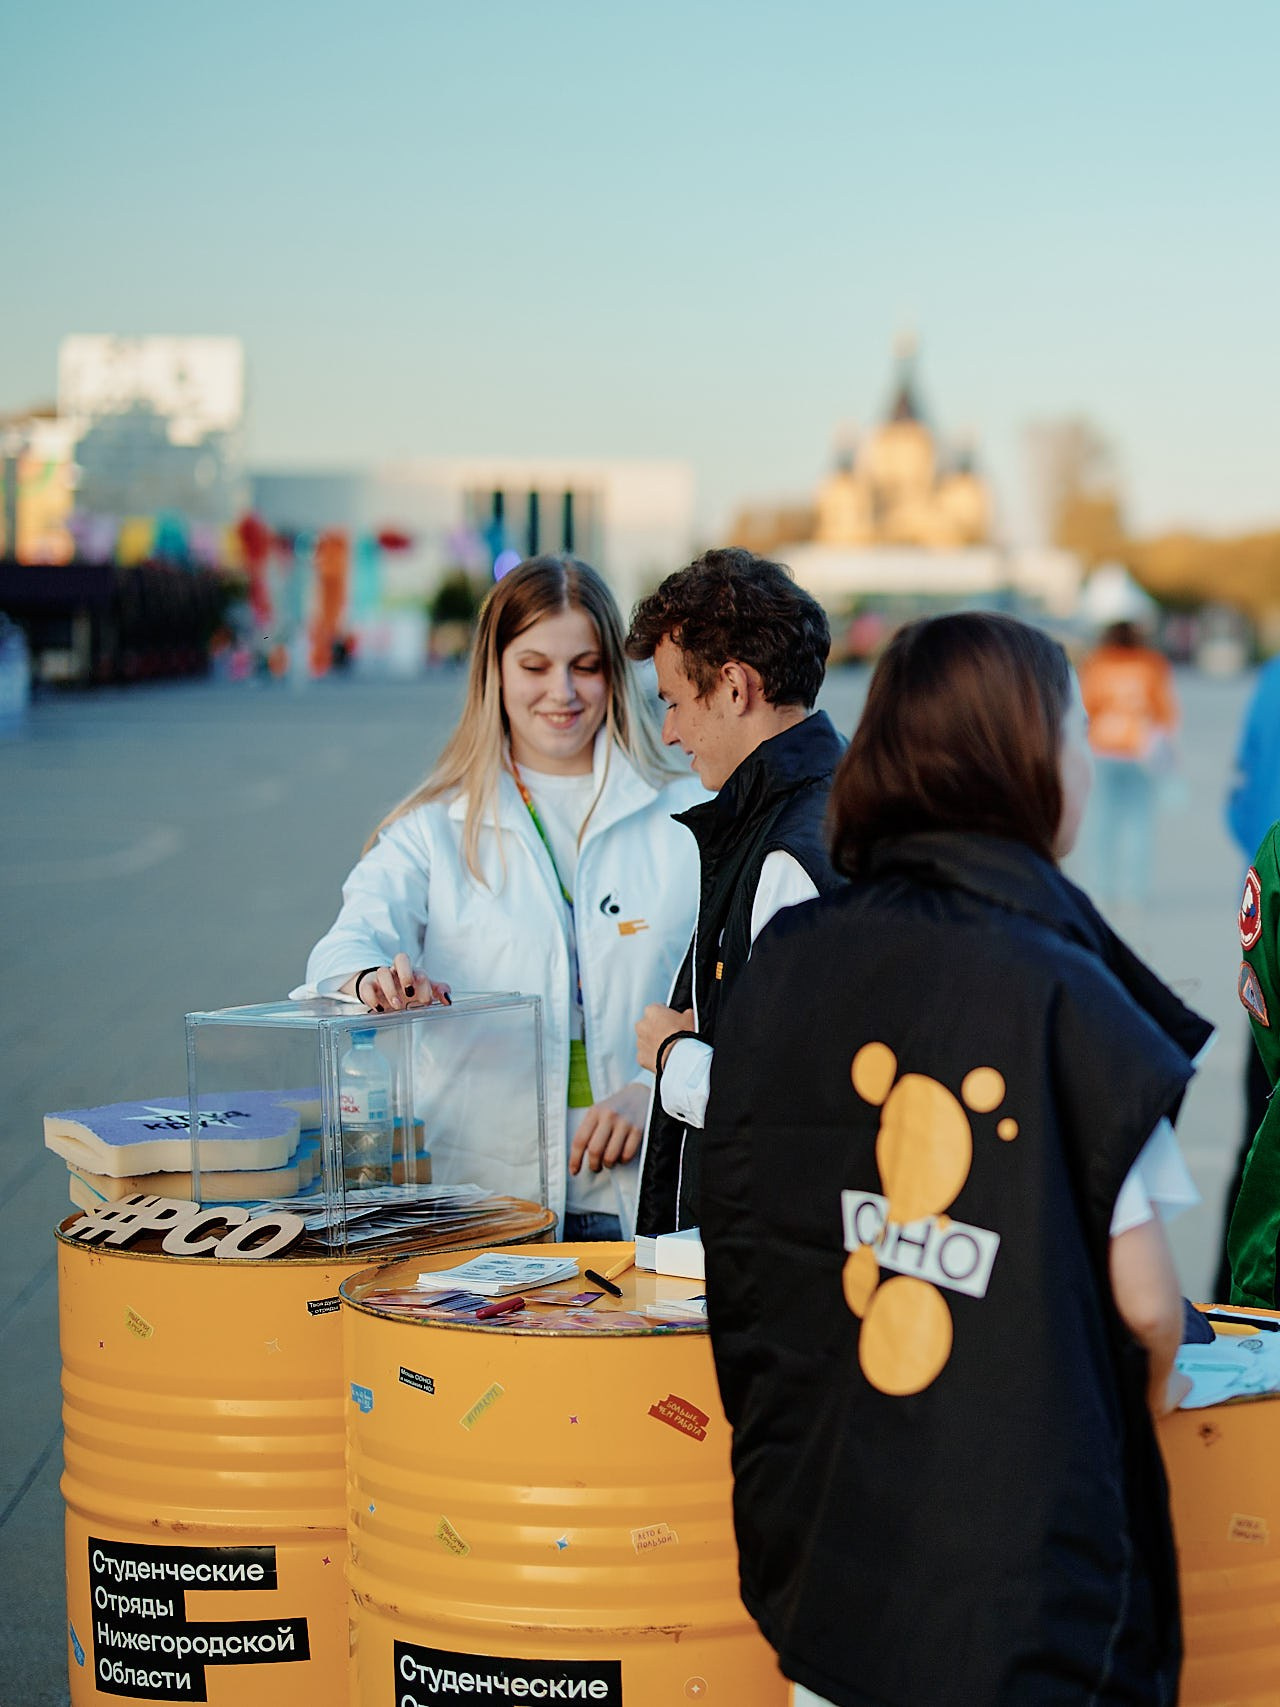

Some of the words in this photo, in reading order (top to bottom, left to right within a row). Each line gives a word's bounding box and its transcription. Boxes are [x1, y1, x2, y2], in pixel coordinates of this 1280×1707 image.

[62, 1193, 305, 1259] #РСО
[674, 1415, 702, 1436] РАБОТА
[92, 1550, 265, 1582] Студенческие
[95, 1586, 174, 1619] Отряды
[97, 1621, 295, 1659] Нижегородской
[99, 1657, 192, 1690] Области
[400, 1654, 608, 1699] Студенческие
